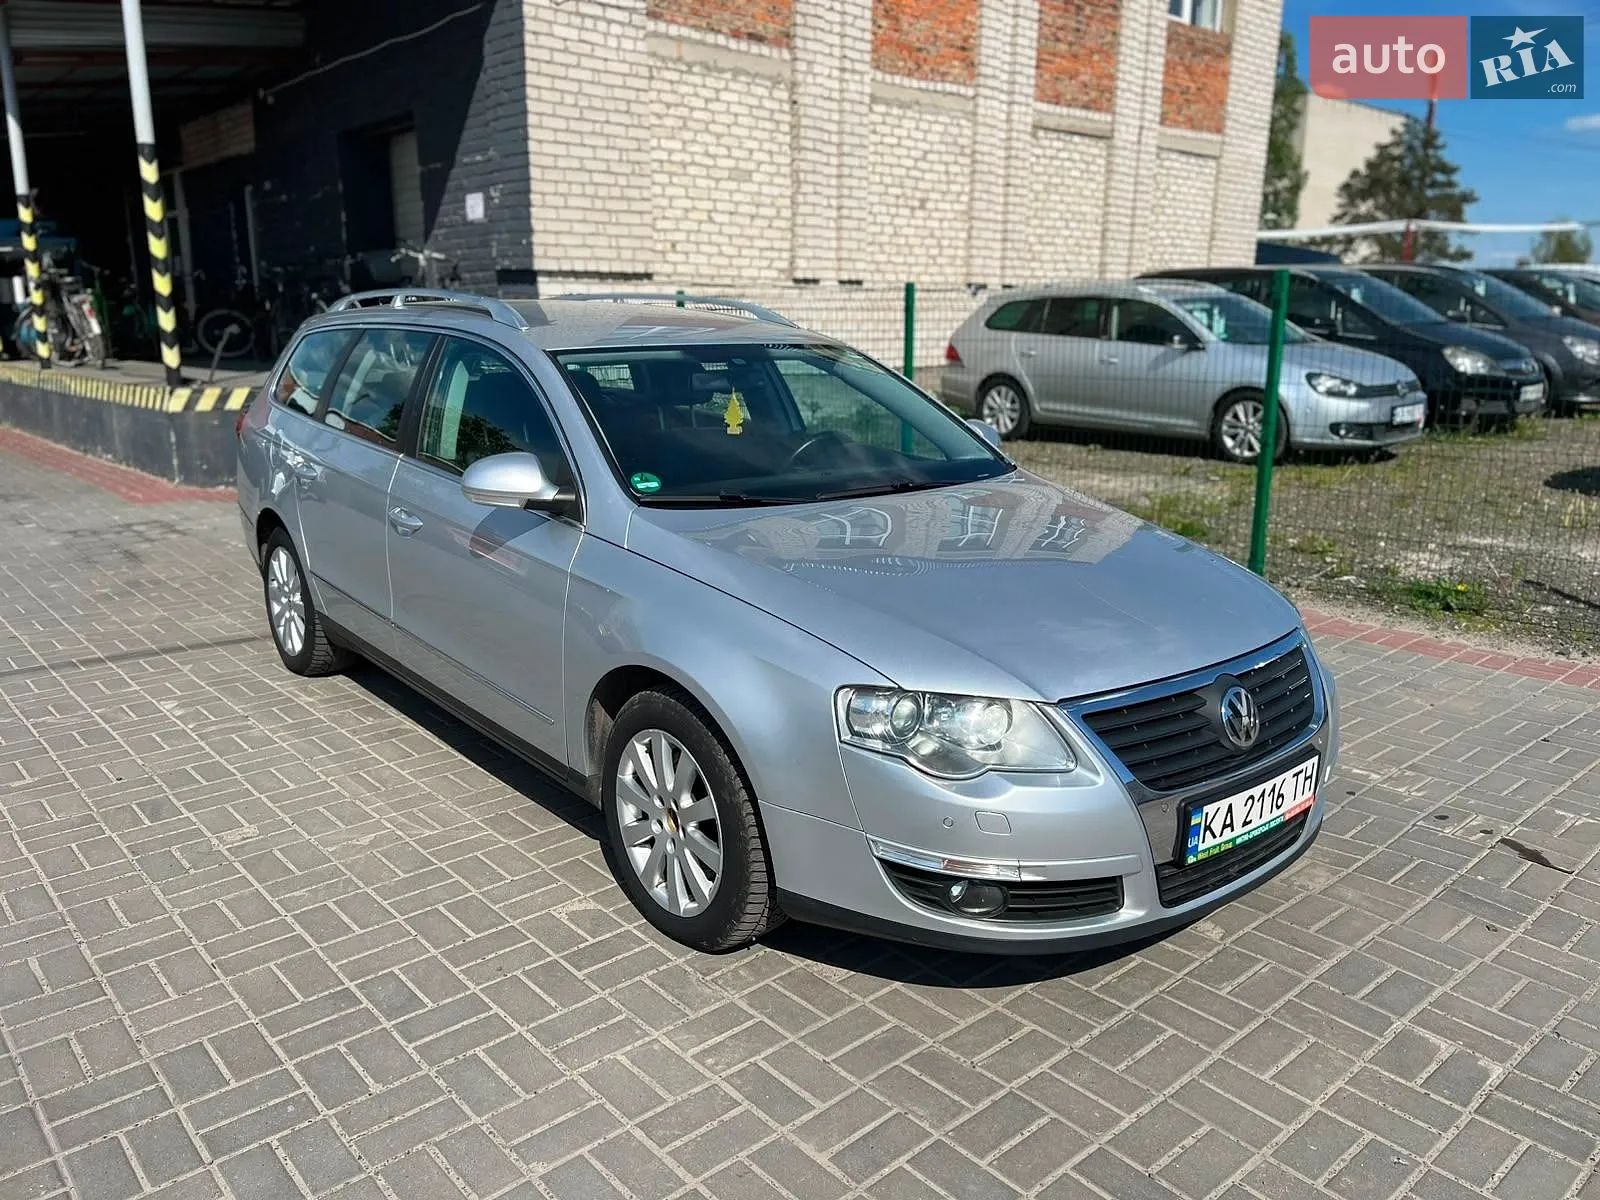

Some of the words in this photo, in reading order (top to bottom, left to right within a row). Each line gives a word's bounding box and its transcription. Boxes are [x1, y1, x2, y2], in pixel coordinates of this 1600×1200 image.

[1201, 803, 1234, 843] KA
[1241, 779, 1285, 827] 2116
[1292, 762, 1315, 801] TH
[1187, 836, 1199, 848] UA
